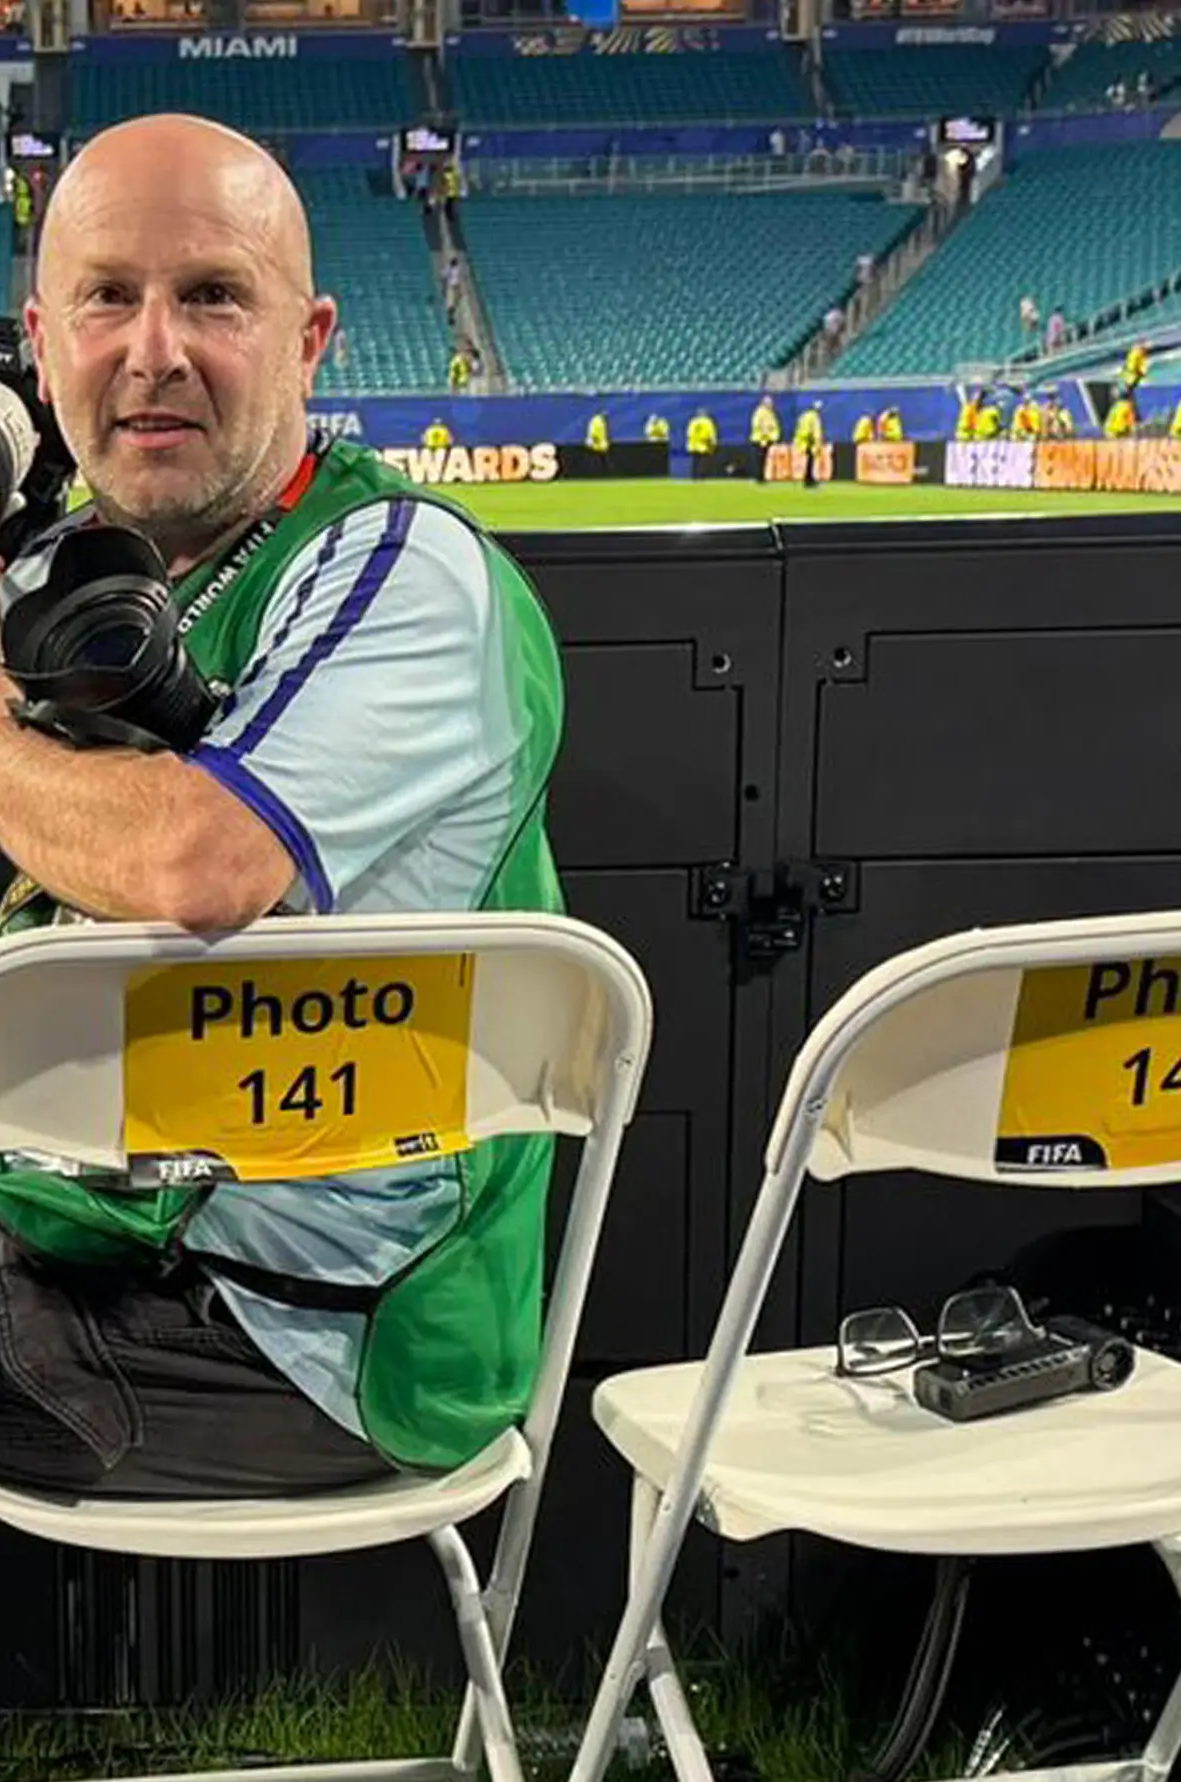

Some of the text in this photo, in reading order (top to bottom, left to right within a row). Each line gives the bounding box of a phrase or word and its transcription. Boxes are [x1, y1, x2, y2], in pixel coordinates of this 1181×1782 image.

[179, 37, 297, 58] MIAMI
[177, 565, 239, 634] WORLD
[191, 978, 414, 1041] Photo
[238, 1061, 356, 1125] 141
[159, 1159, 213, 1182] FIFA
[1027, 1143, 1083, 1164] FIFA
